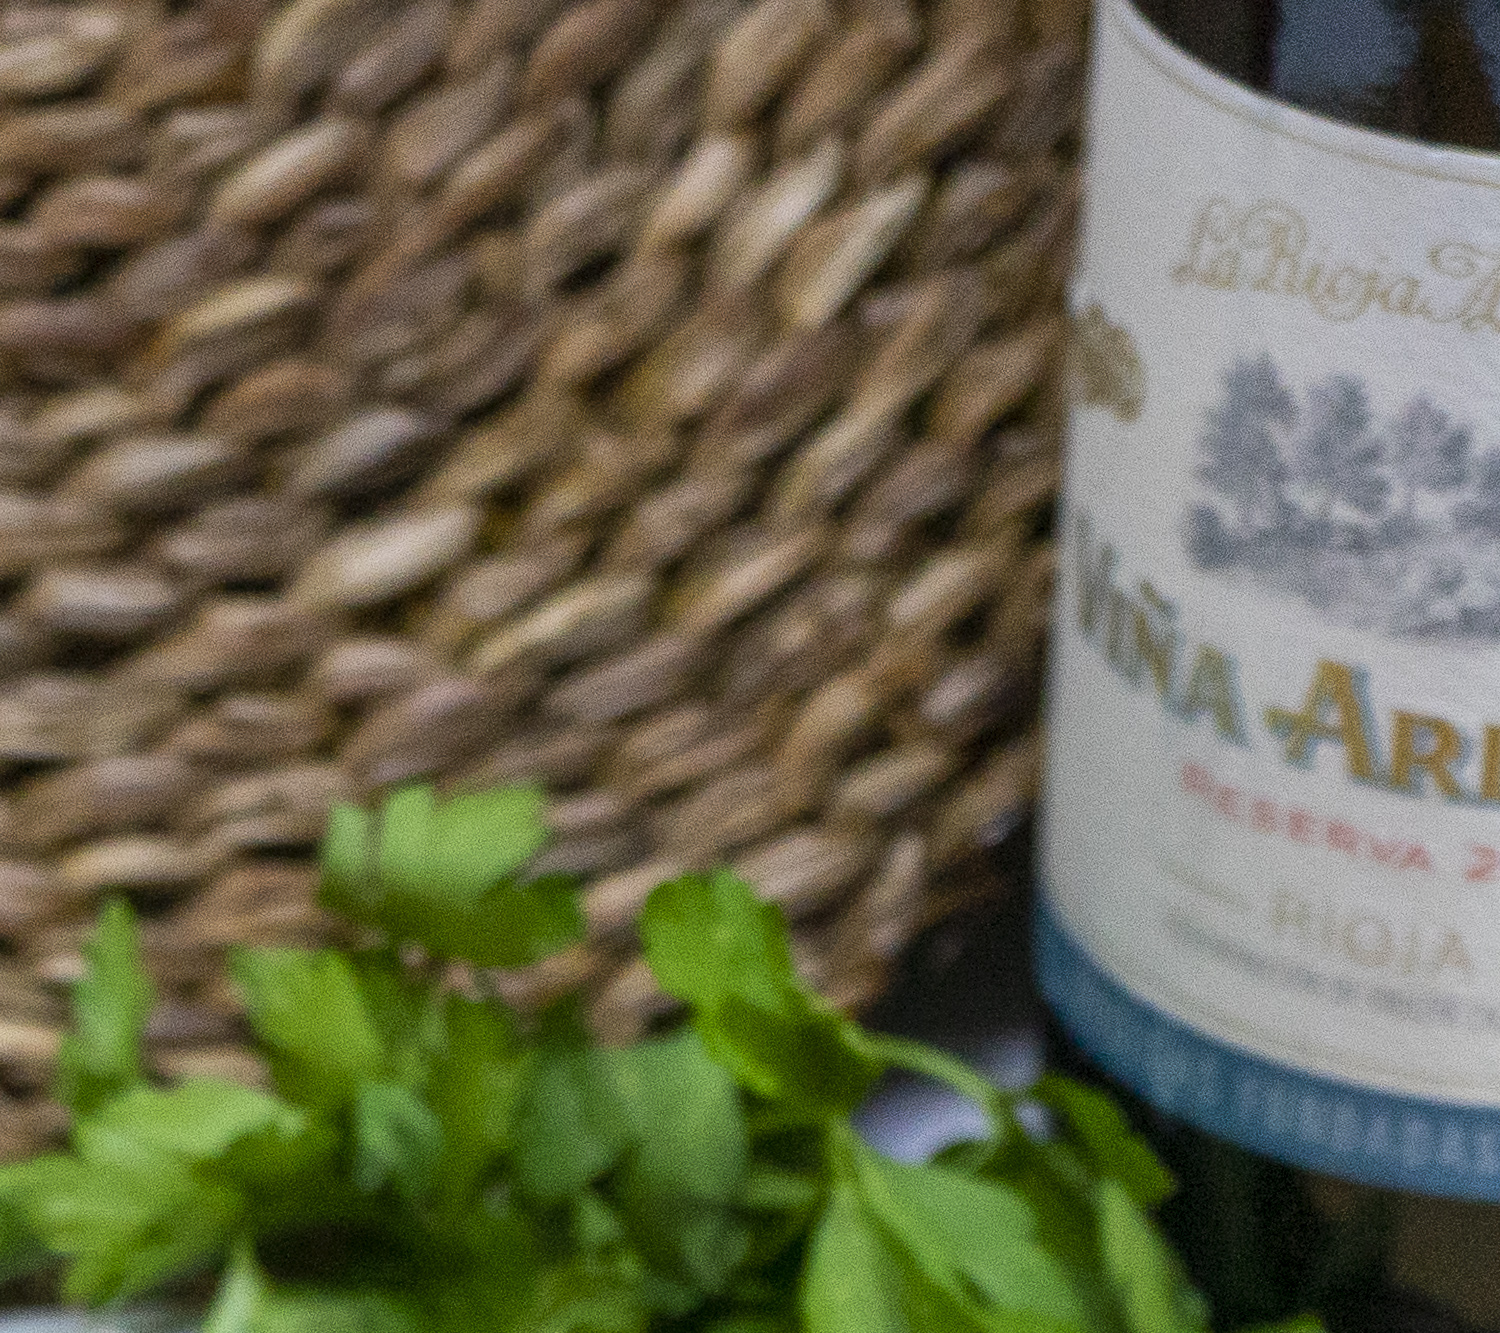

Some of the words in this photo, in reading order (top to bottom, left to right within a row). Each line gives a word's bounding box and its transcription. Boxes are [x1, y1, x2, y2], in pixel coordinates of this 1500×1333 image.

[1169, 195, 1240, 289] La
[1239, 199, 1430, 322] Rioja
[1180, 760, 1434, 872] RESERVA
[1269, 886, 1474, 980] RIOJA
